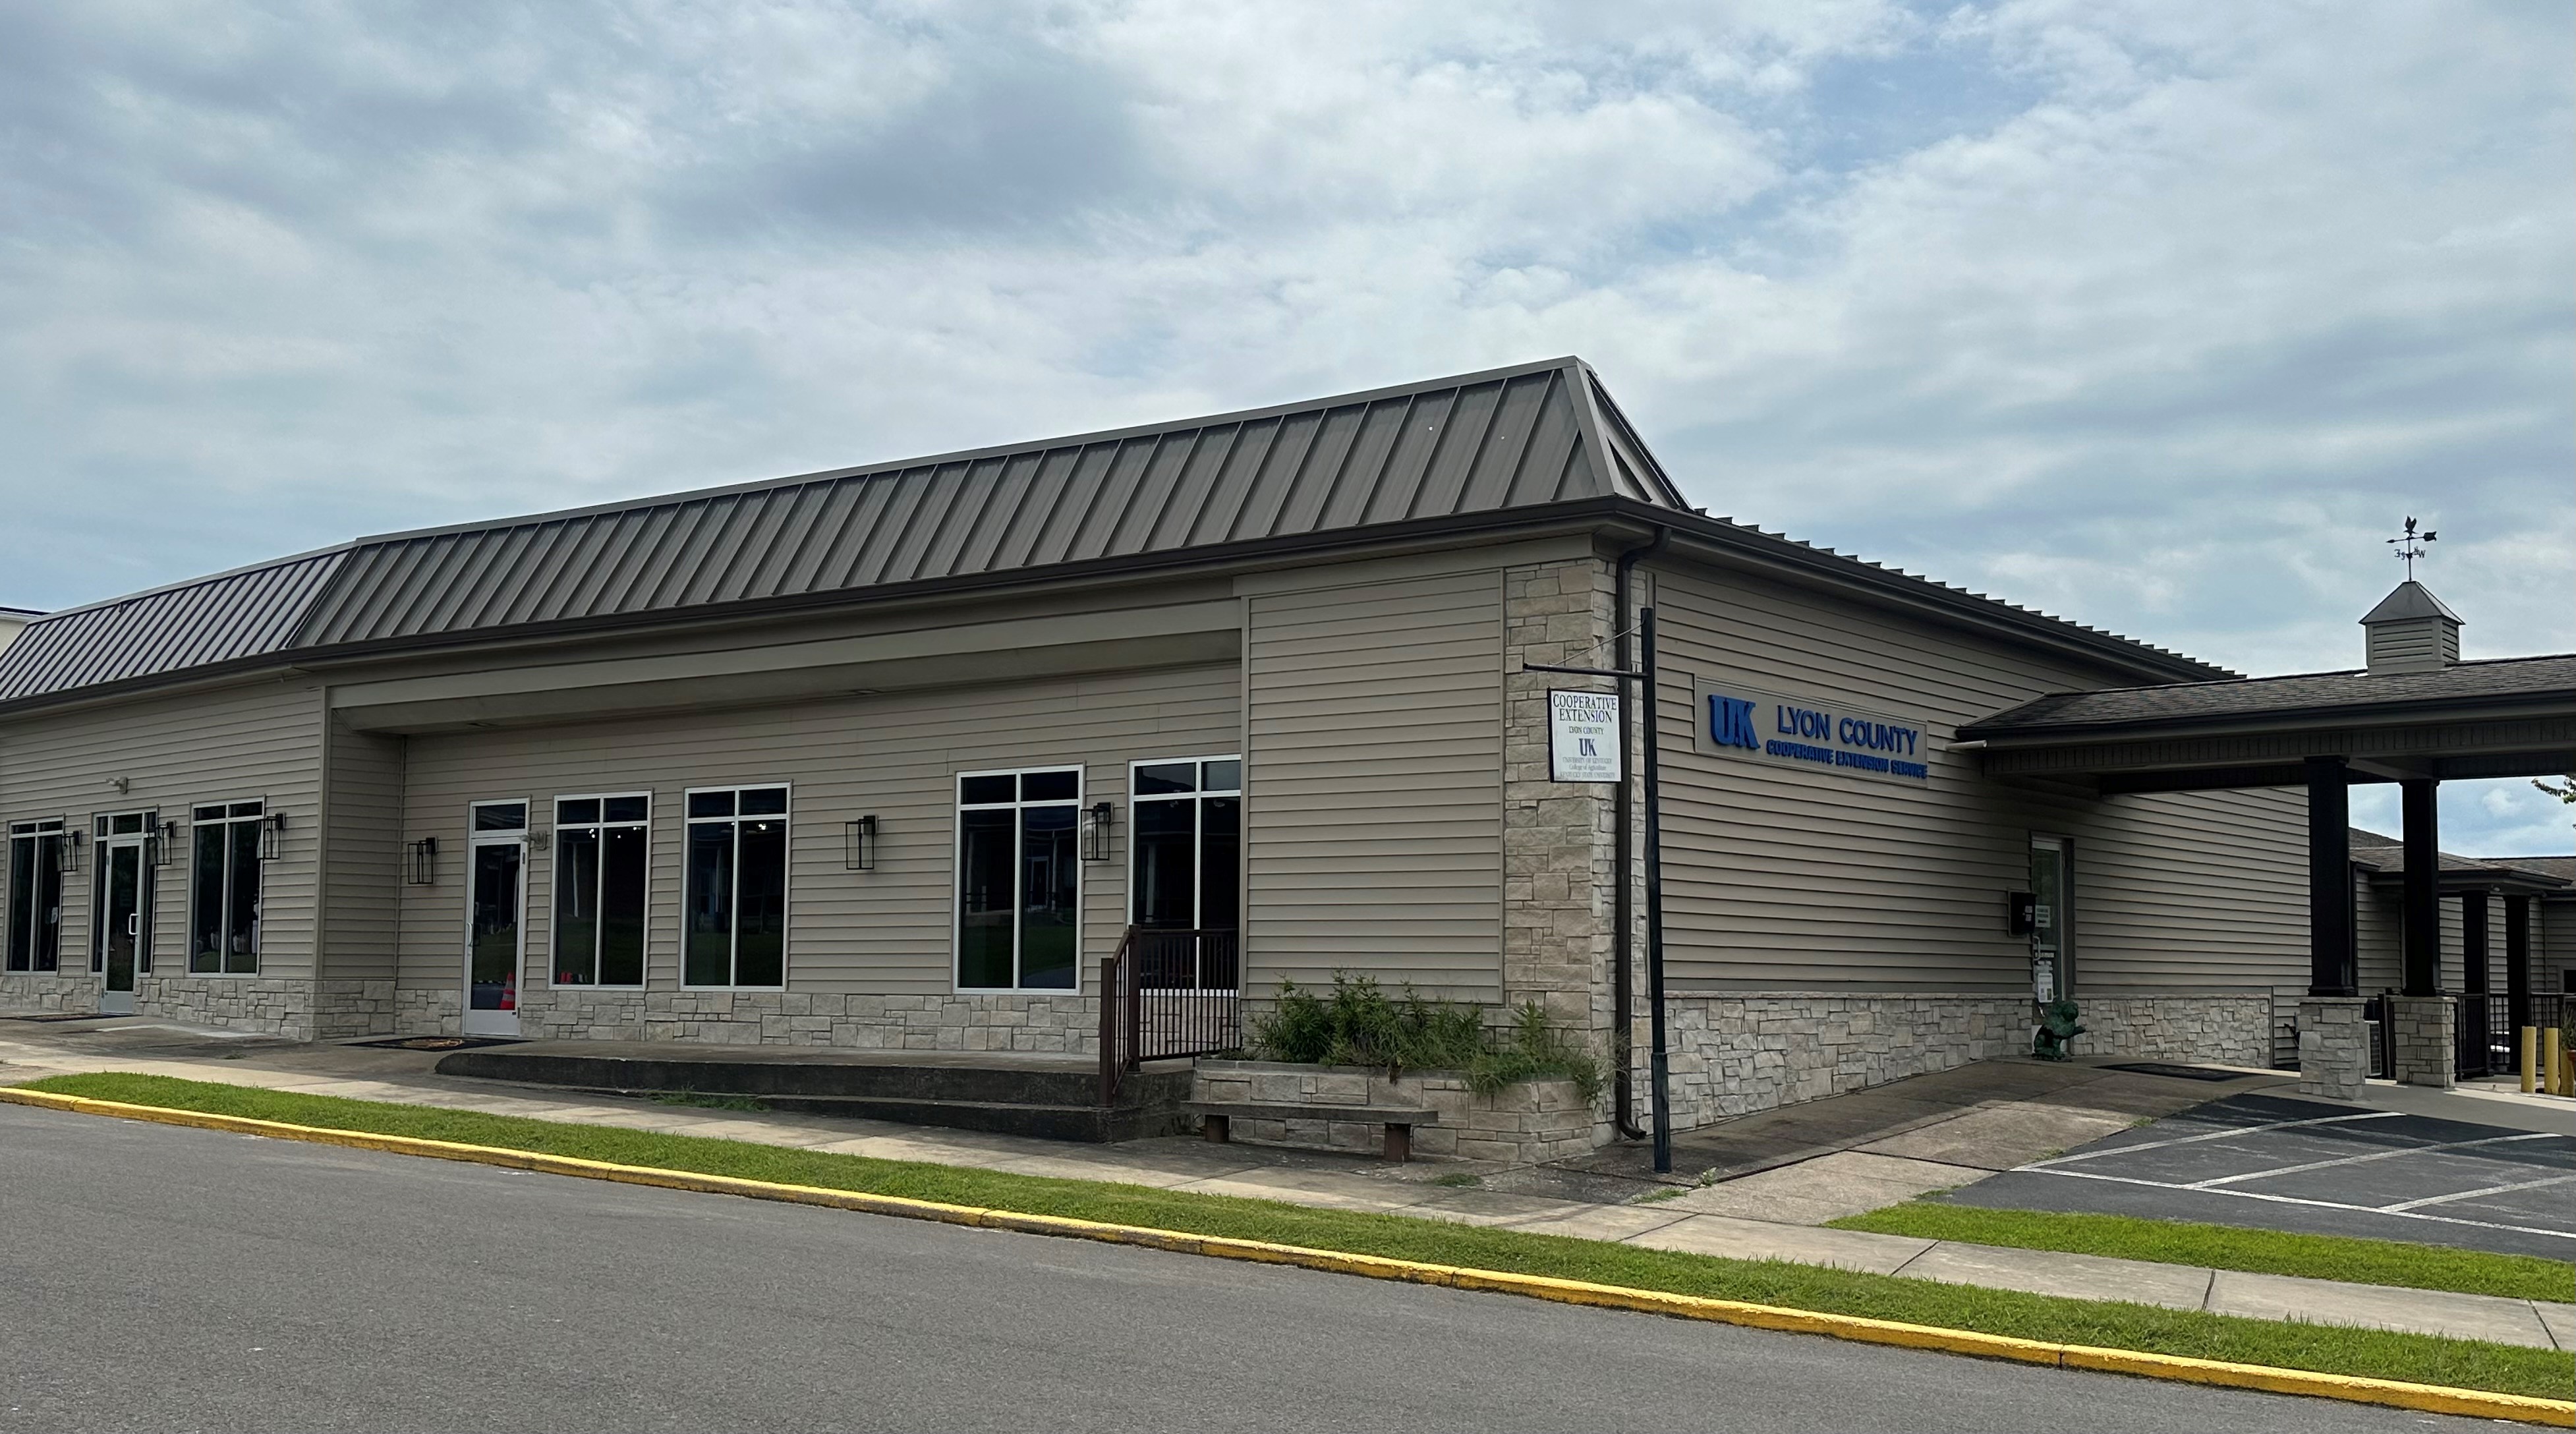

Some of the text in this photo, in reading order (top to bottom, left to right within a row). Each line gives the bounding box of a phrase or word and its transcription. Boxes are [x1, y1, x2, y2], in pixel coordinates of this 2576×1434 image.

[1553, 694, 1617, 710] COOPERATIVE
[1559, 708, 1612, 723] EXTENSION
[1707, 694, 1761, 750] UK
[1568, 726, 1582, 734] LYON
[1777, 704, 1918, 755] LYON COUNTY
[1579, 738, 1597, 757] UK
[1766, 739, 1928, 780] COOPERATIVE EXTENSION SERVICE
